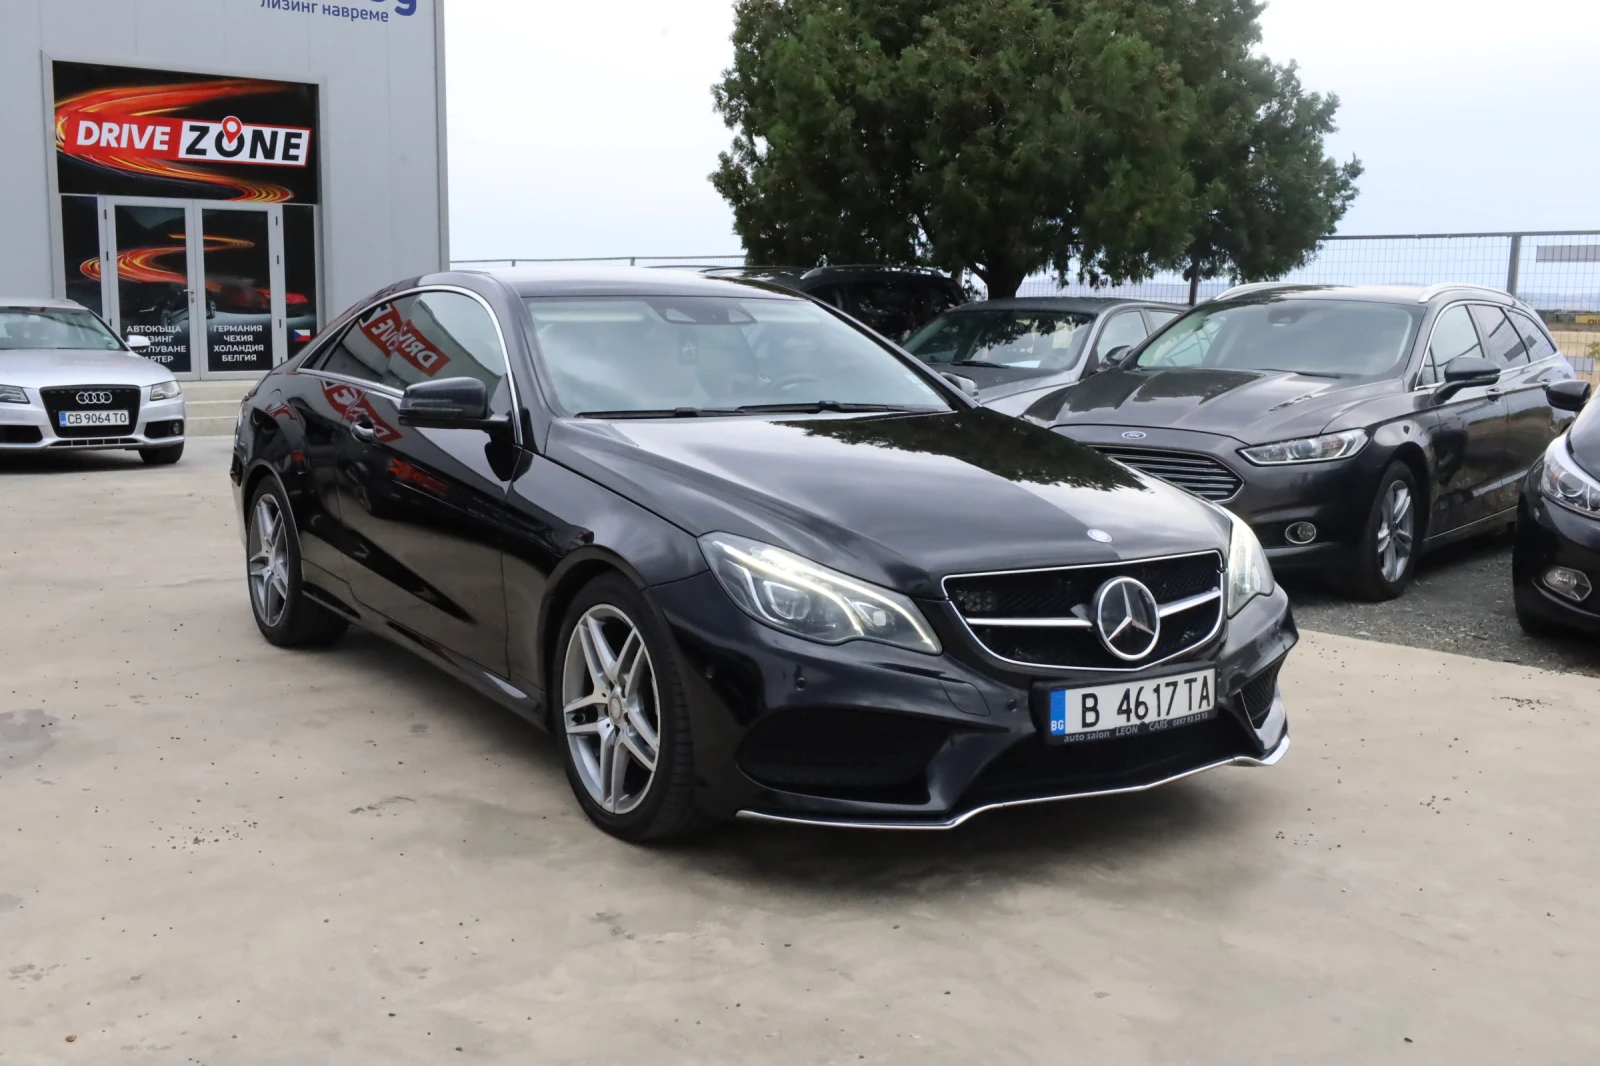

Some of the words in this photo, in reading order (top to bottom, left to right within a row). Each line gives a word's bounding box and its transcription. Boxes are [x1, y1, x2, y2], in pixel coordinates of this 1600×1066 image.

[322, 4, 389, 22] навреме
[76, 120, 171, 150] DRIVE
[185, 124, 303, 162] ZONE
[126, 325, 182, 333] АВТОКЪЩА
[213, 324, 263, 332] ГЕРМАНИЯ
[223, 334, 254, 342] ЧЕХИЯ
[213, 344, 264, 352] ХОЛАНДИЯ
[221, 354, 257, 362] БЕЛГИЯ
[67, 413, 83, 424] CB
[84, 412, 111, 424] 9064
[1051, 719, 1065, 731] BG
[1081, 692, 1100, 729] B
[1117, 680, 1179, 723] 4617
[1184, 675, 1211, 711] TA
[1064, 733, 1085, 743] auto
[1086, 730, 1110, 740] salon
[1115, 725, 1139, 737] LEON
[1149, 720, 1168, 731] CARS
